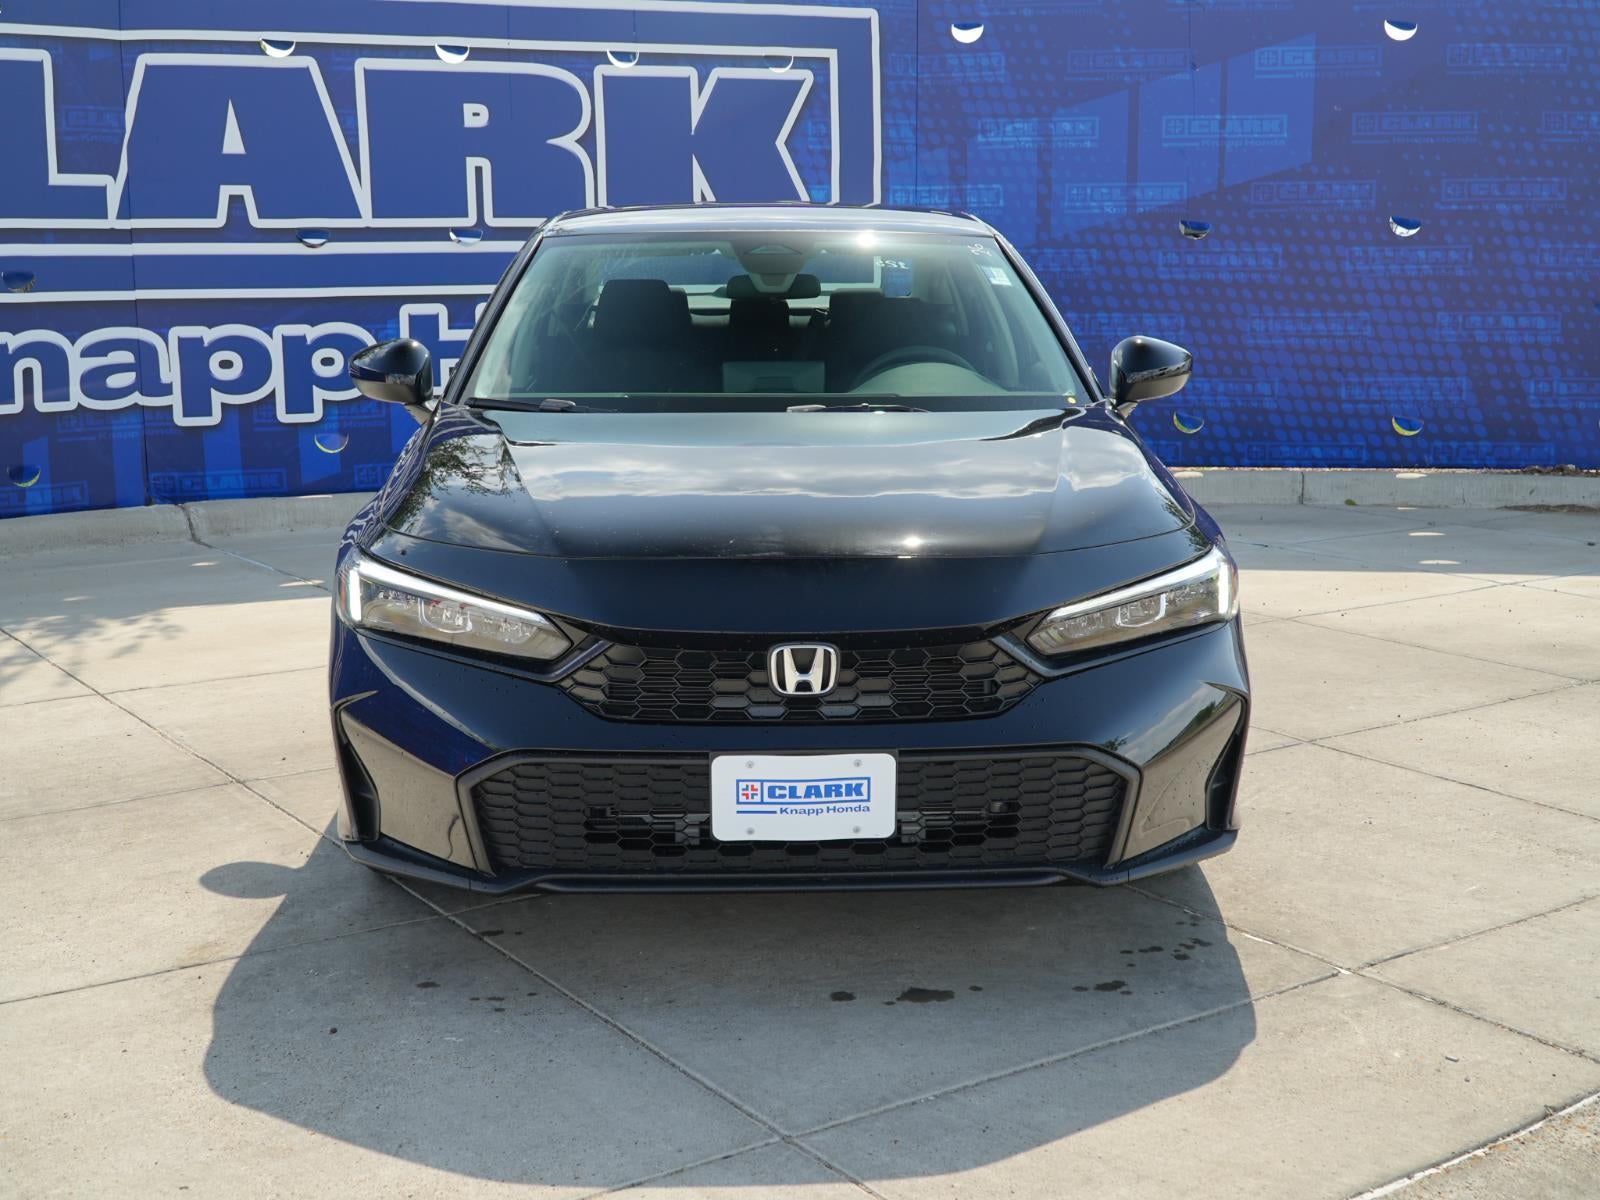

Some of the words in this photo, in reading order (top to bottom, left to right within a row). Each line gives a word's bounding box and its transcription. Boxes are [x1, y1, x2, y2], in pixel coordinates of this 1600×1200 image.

[1190, 119, 1282, 133] CLARK
[767, 783, 864, 799] CLARK
[780, 807, 824, 816] Knapp
[826, 804, 870, 813] Honda
